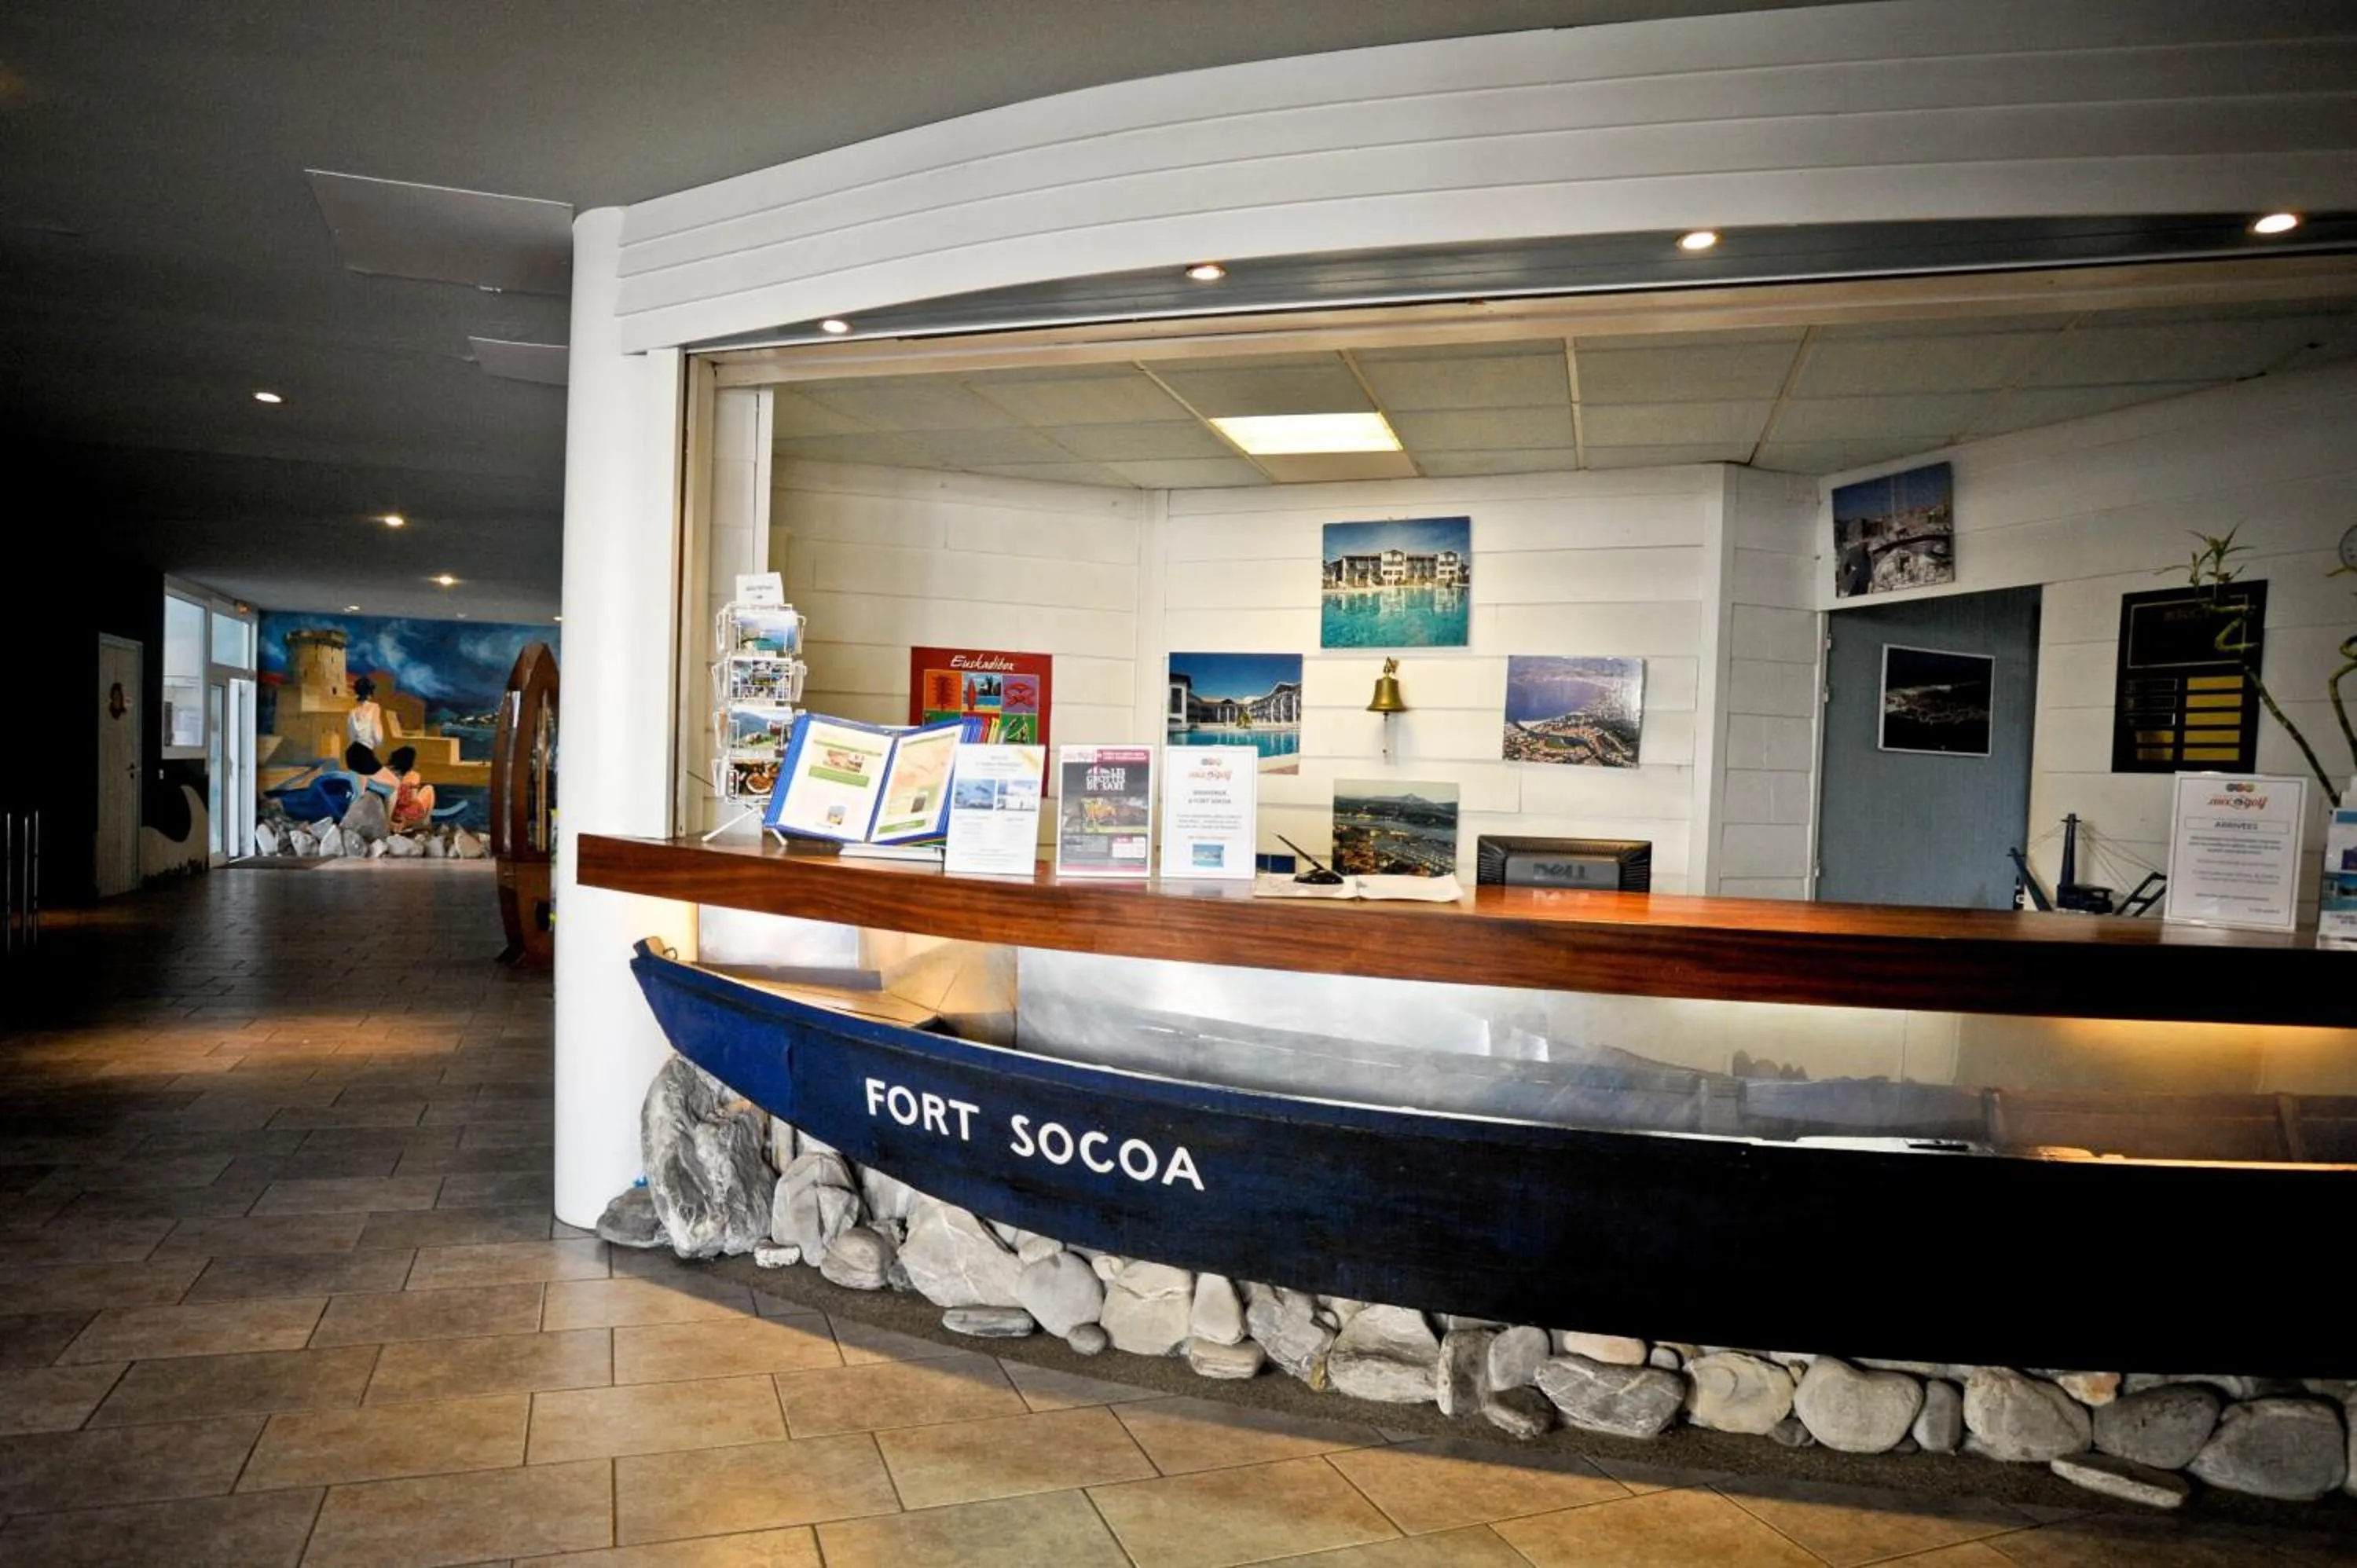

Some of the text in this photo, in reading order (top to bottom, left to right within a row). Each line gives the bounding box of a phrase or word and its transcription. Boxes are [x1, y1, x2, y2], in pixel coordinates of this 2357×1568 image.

[1533, 863, 1588, 881] DELL
[865, 1077, 1205, 1191] FORT SOCOA
